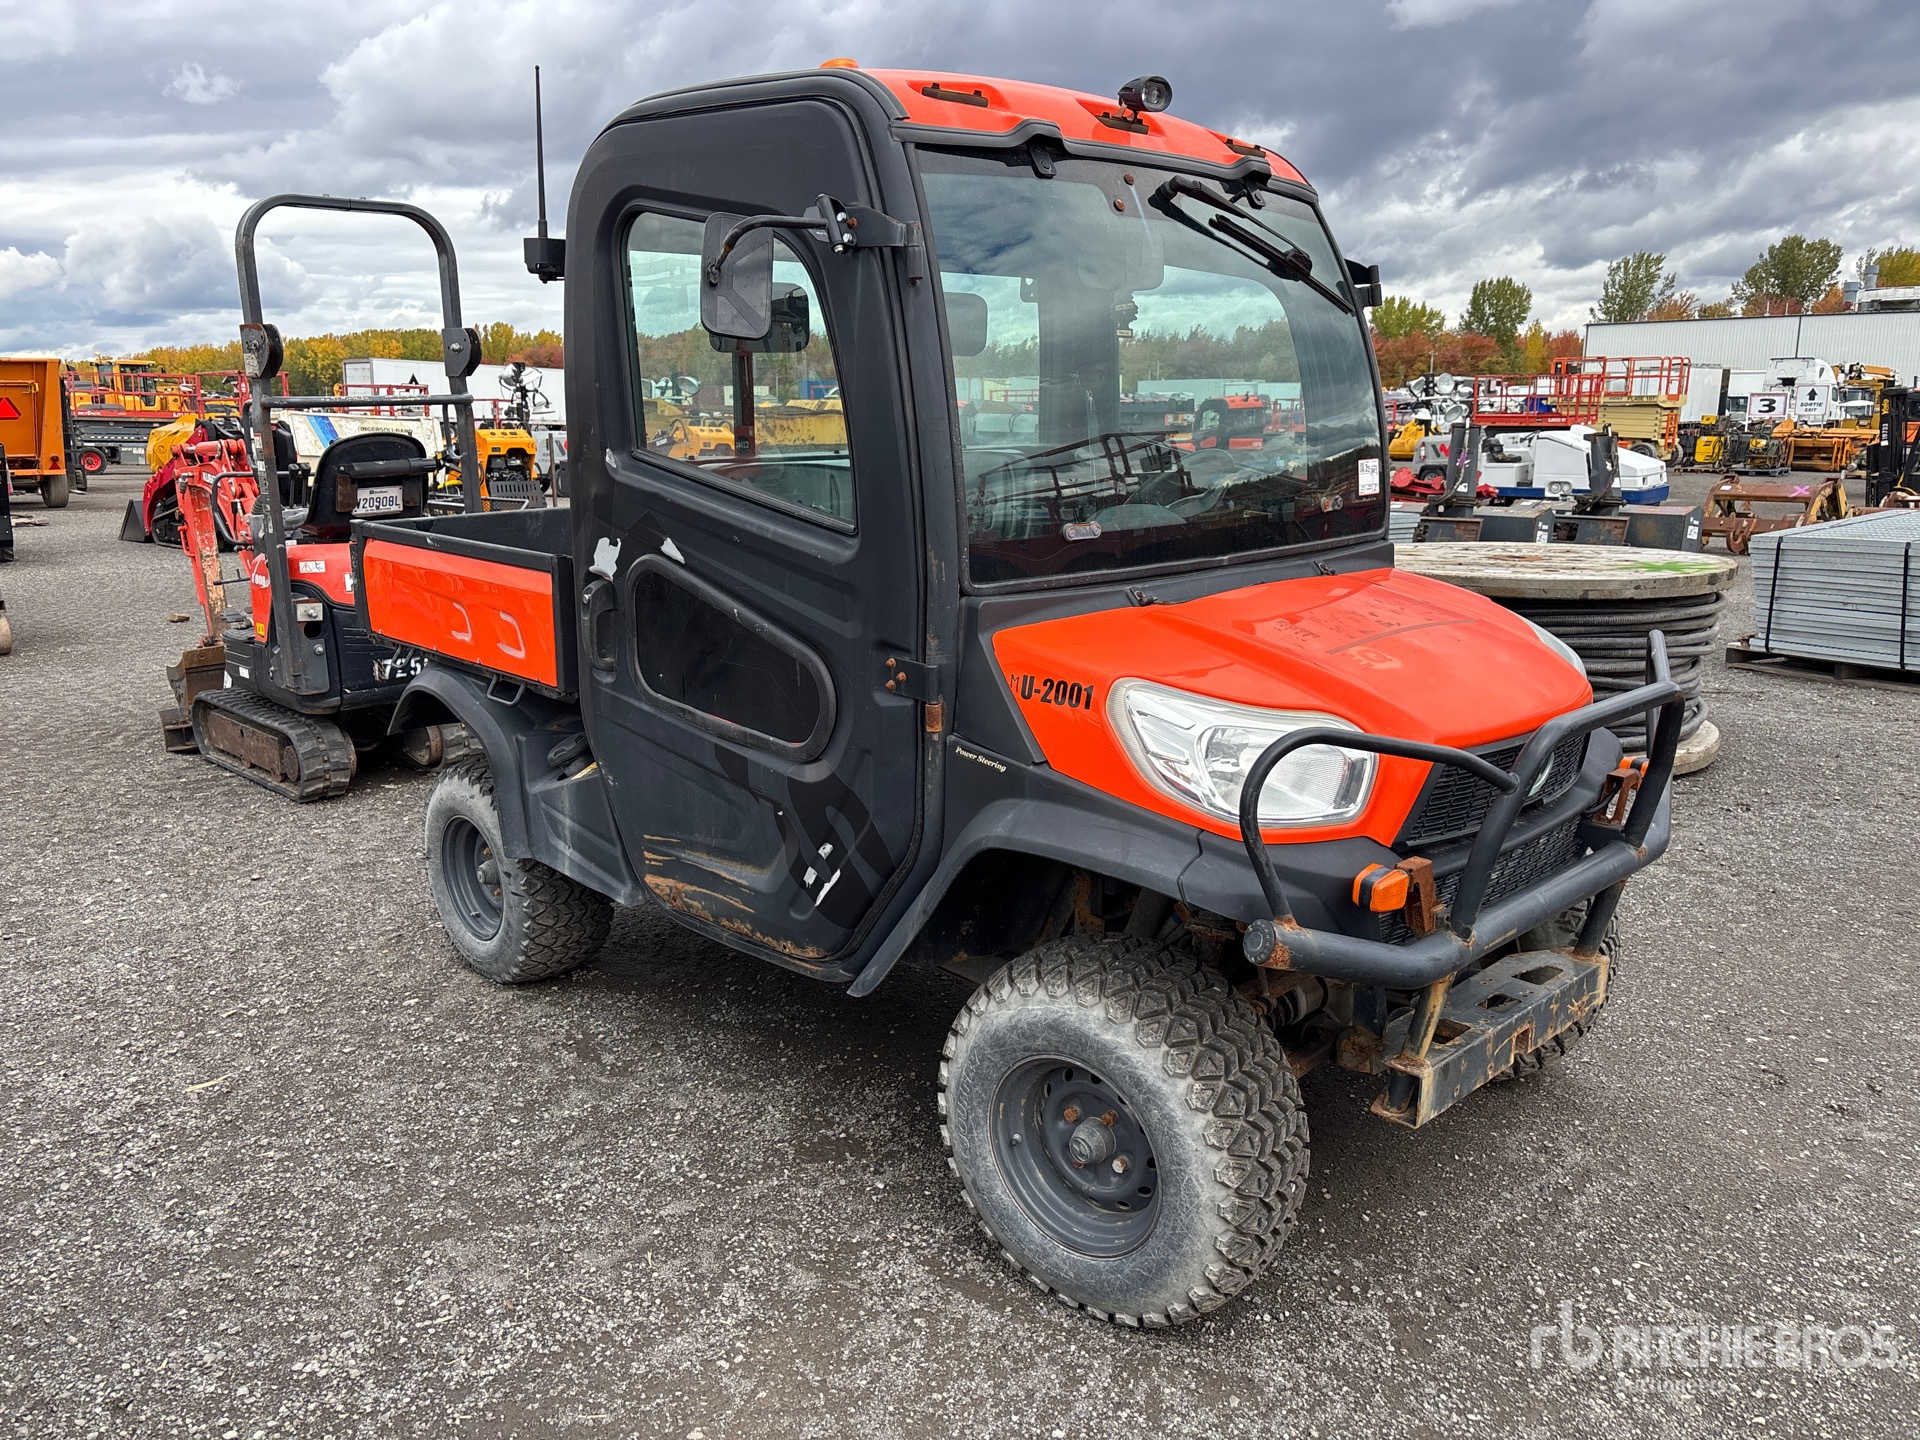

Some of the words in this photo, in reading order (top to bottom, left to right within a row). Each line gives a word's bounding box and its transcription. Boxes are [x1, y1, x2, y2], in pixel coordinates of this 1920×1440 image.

[1758, 398, 1776, 413] 3
[955, 745, 977, 760] Power
[976, 755, 1007, 773] Steering
